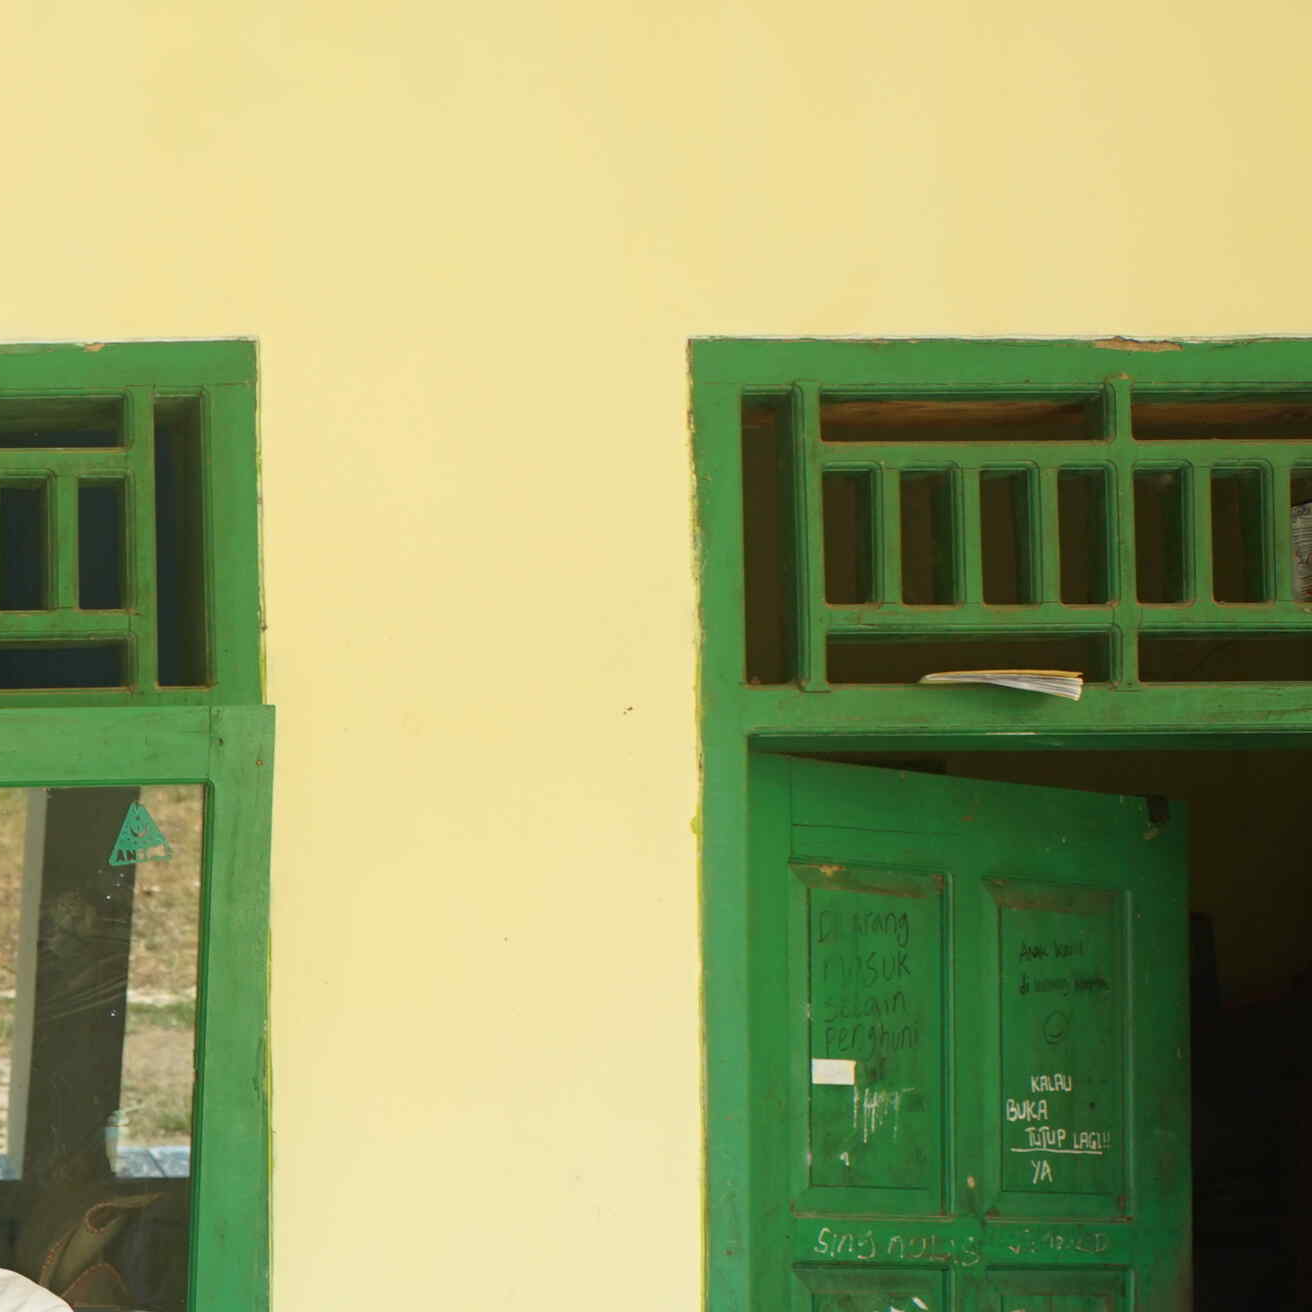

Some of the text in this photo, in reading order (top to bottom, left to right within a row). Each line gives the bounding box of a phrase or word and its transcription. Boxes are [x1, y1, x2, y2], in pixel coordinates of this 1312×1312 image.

[1031, 1073, 1073, 1092] KALAU
[1006, 1098, 1048, 1122] BUKA
[1025, 1126, 1066, 1149] TUTUP
[1031, 1159, 1053, 1184] YA
